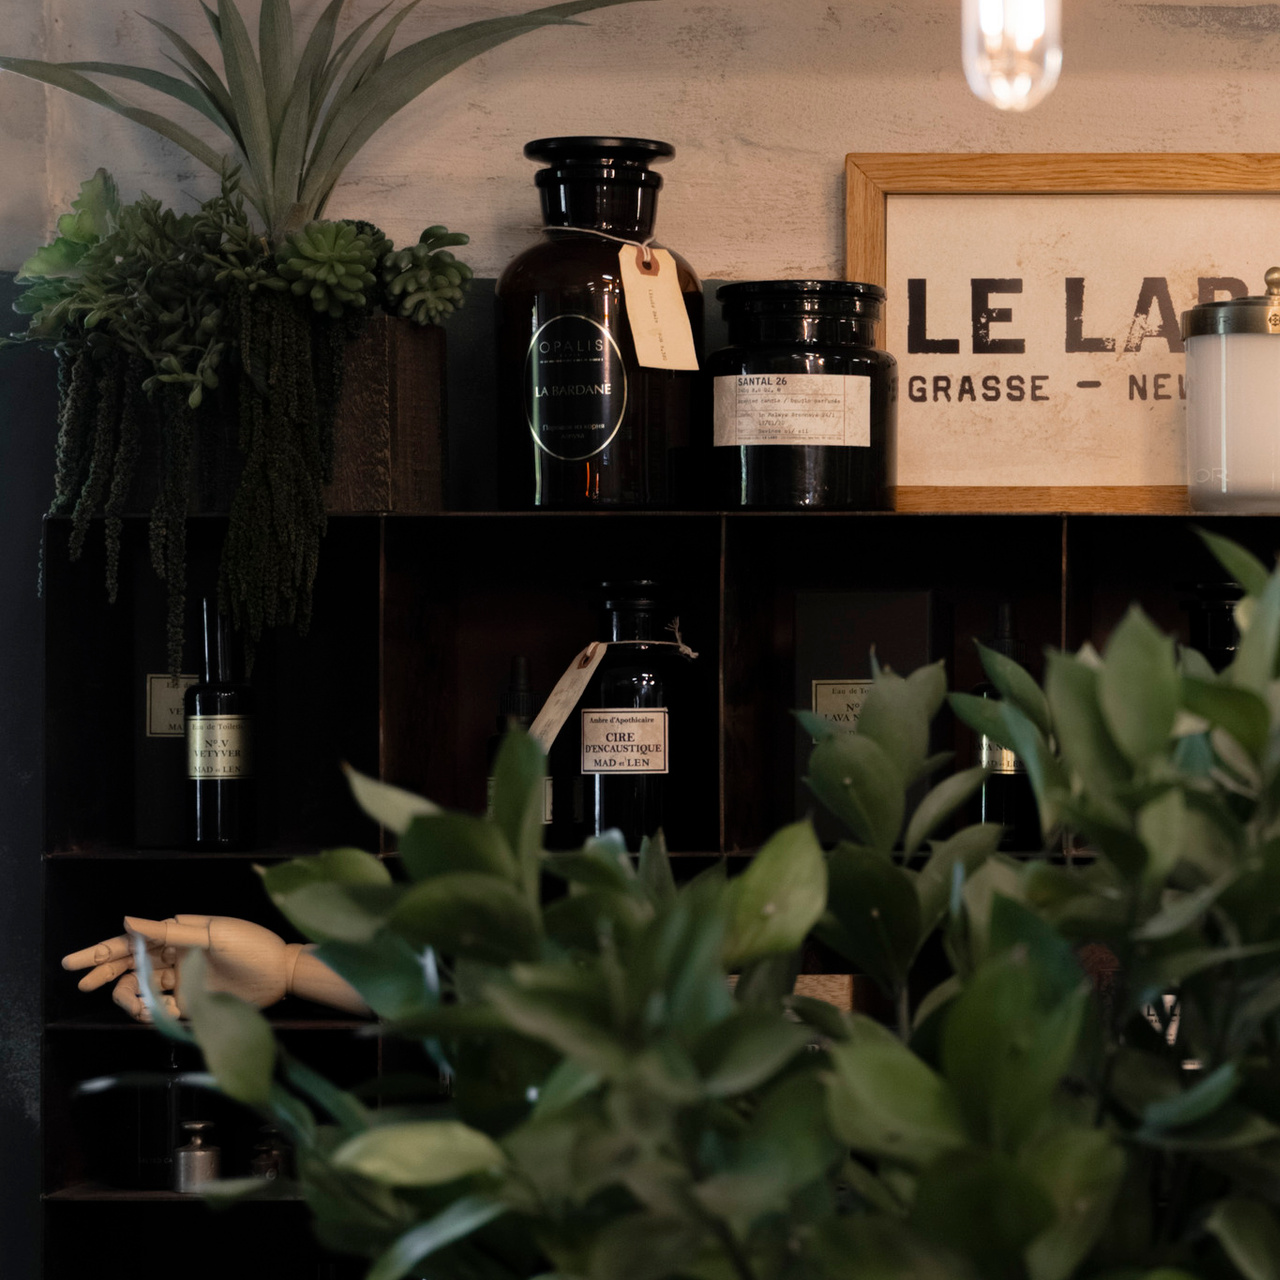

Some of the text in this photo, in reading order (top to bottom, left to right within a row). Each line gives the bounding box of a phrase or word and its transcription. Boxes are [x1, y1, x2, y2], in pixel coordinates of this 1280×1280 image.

[908, 278, 1025, 354] LE
[539, 339, 604, 354] OPALIS
[738, 376, 787, 386] SANTAL 26
[535, 383, 612, 397] LA BARDANE
[908, 375, 1050, 402] GRASSE
[589, 716, 654, 725] Ambre d'Apothicaire
[606, 732, 636, 742] CIRE
[195, 749, 241, 757] VETYVER
[585, 744, 662, 755] D'ENCAUSTIQUE
[594, 759, 650, 767] MAD LEN
